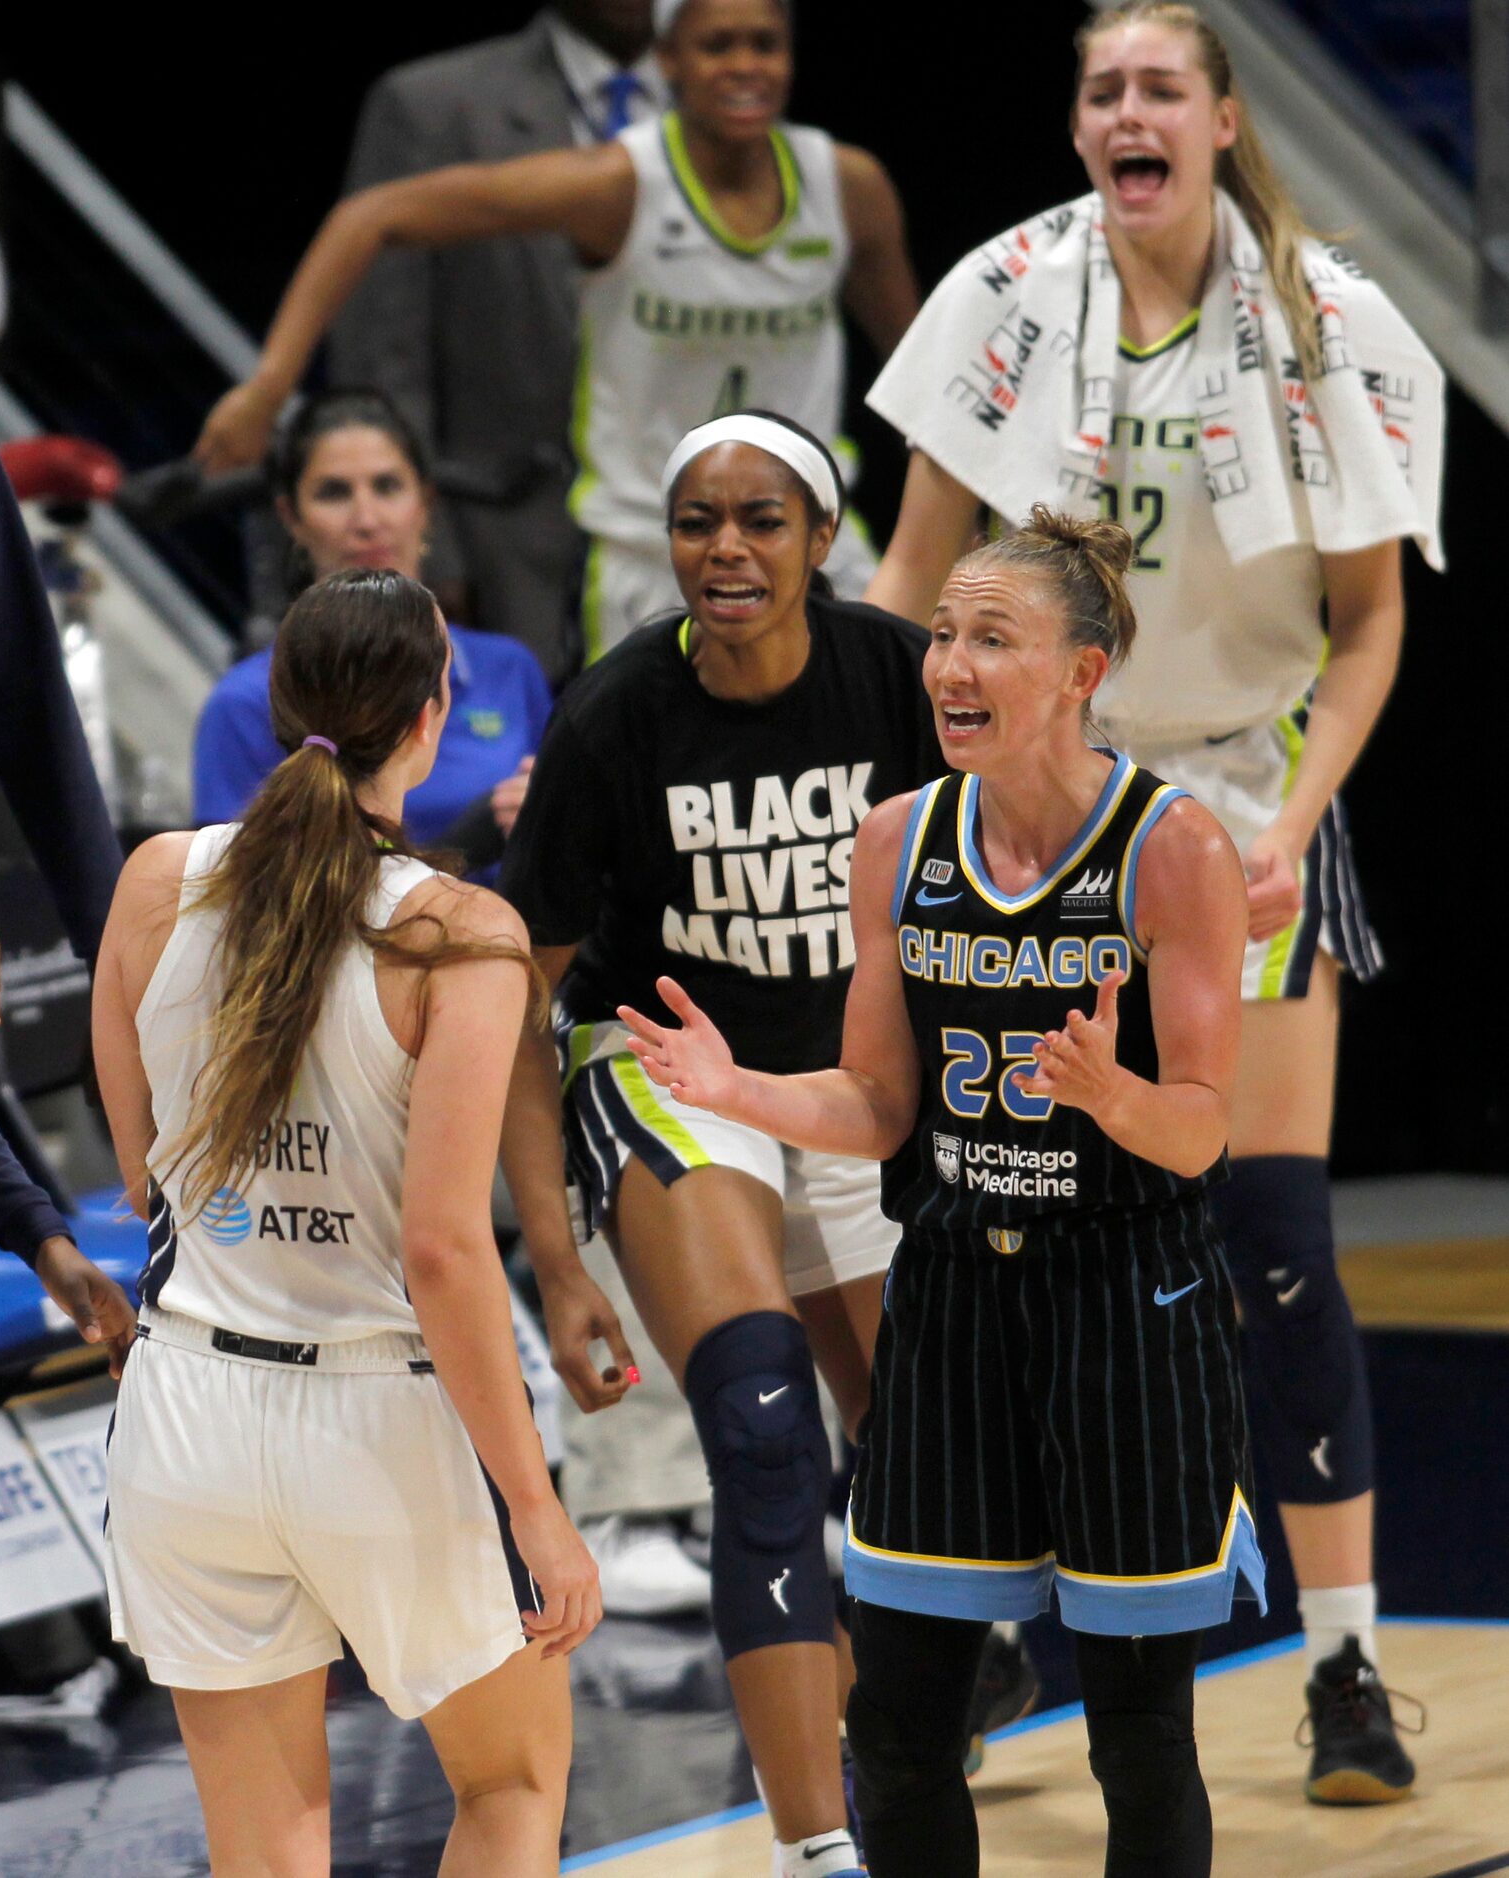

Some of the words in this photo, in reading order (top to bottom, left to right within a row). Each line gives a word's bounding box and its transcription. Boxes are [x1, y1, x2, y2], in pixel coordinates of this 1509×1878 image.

[666, 762, 873, 852] BLACK
[693, 837, 853, 914] LIVES
[898, 925, 1131, 988] CHICAGO
[941, 1027, 1058, 1121] 22
[965, 1141, 1077, 1173] UChicago
[965, 1167, 1077, 1197] Medicine
[258, 1205, 355, 1245] AT&T
